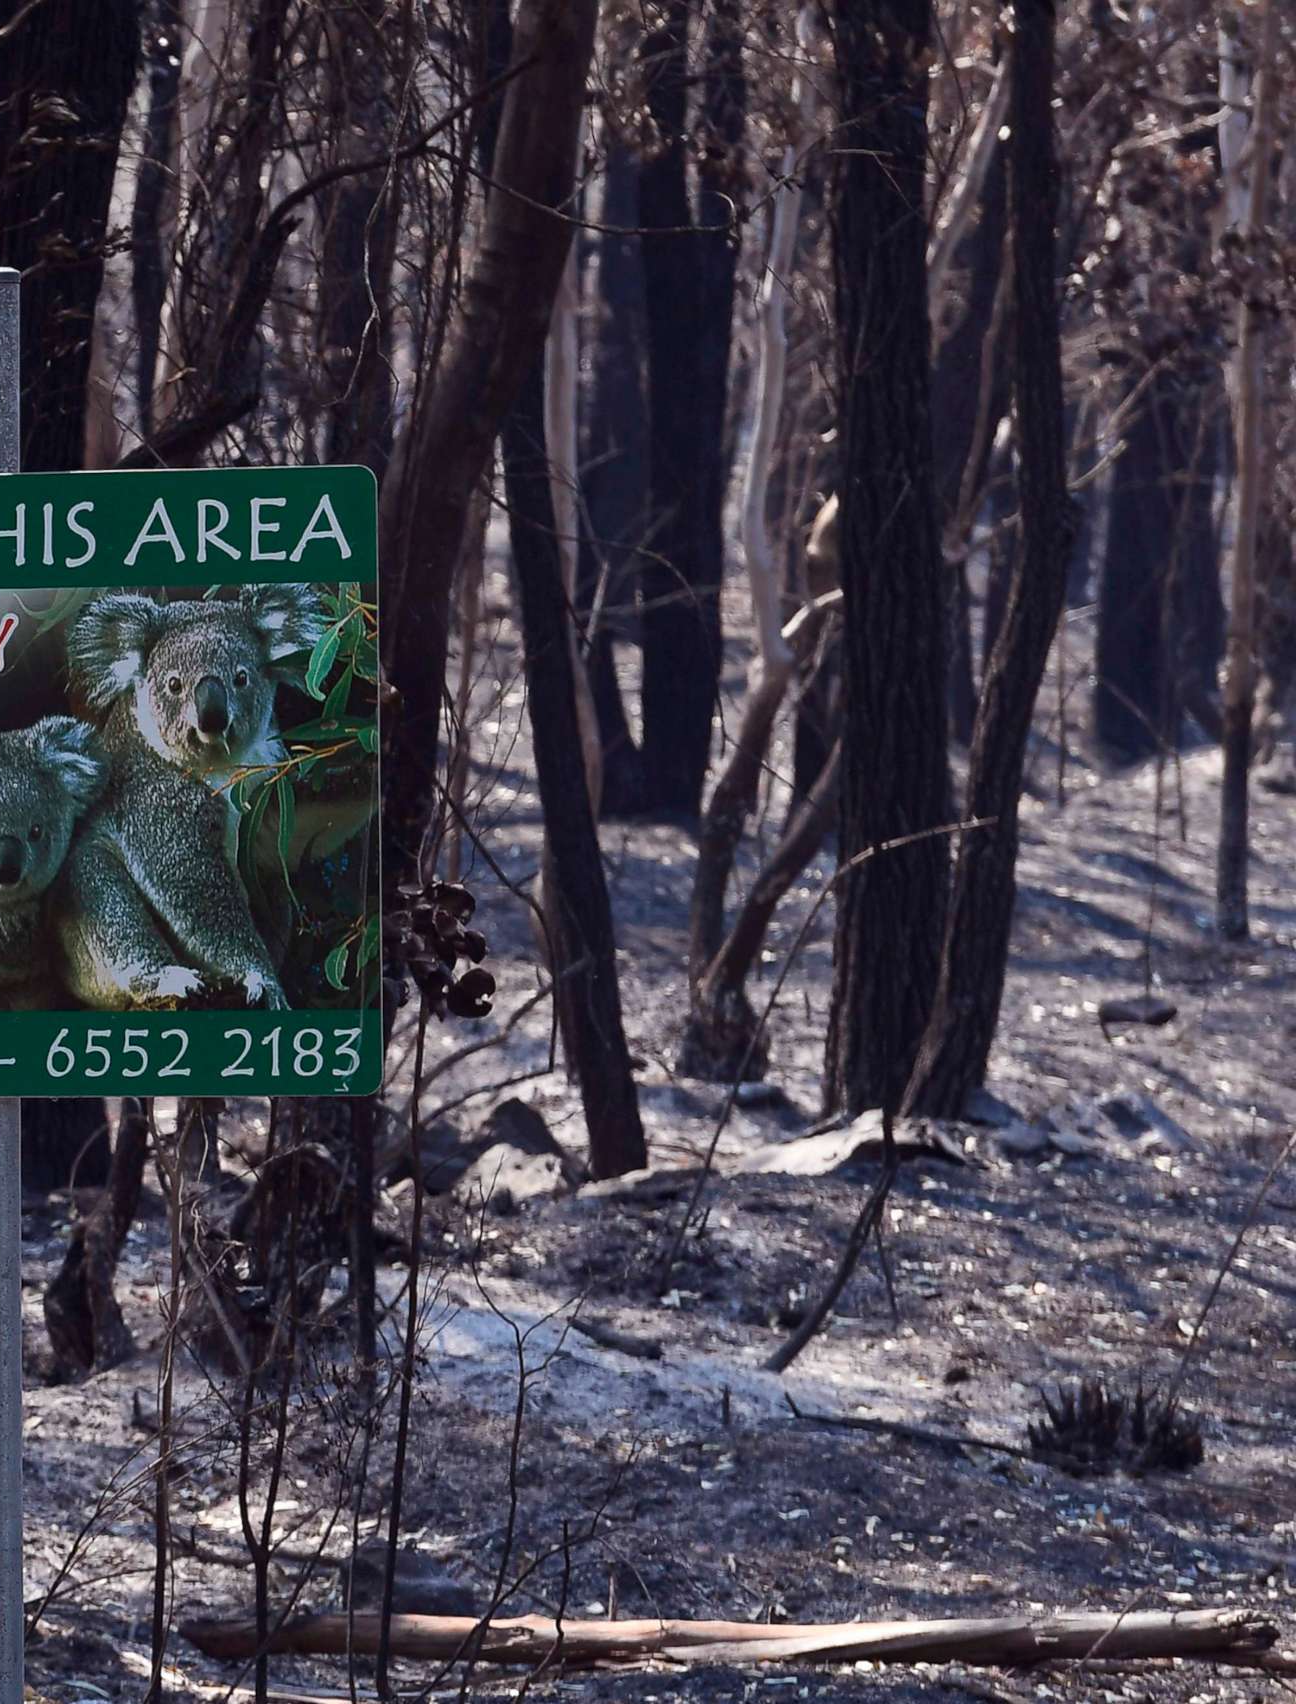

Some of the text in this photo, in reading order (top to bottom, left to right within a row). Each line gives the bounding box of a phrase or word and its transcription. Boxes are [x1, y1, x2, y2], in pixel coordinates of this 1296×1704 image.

[124, 494, 353, 566] AREA
[45, 1026, 193, 1078] 6552
[221, 1026, 363, 1079] 2183
